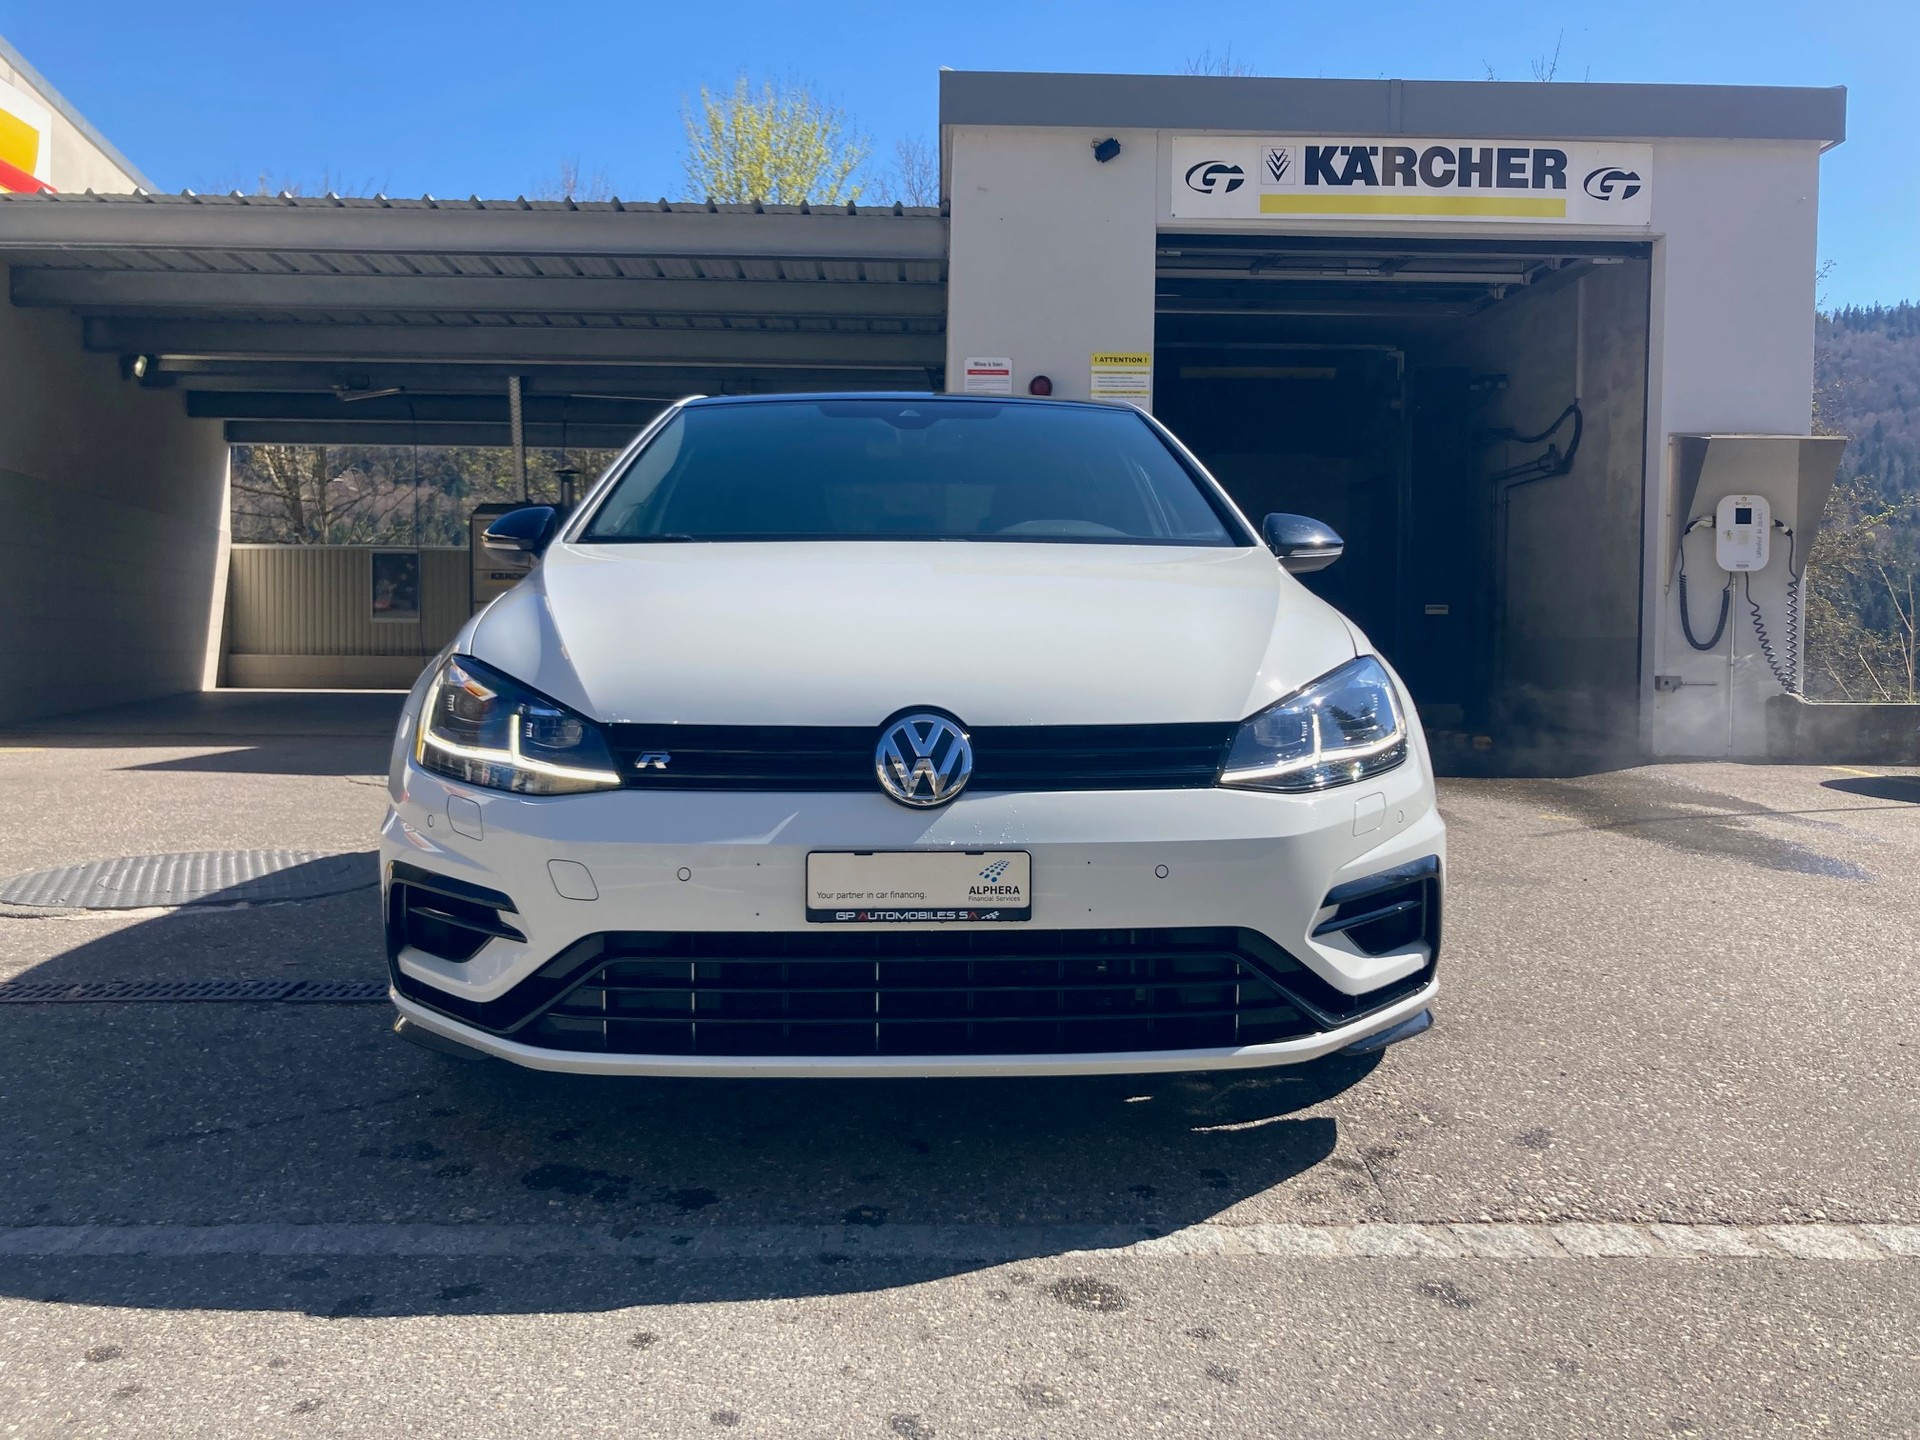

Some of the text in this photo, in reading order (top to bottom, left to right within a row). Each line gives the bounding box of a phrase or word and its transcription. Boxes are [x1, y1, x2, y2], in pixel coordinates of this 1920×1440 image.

[1304, 145, 1568, 189] KÄRCHER
[634, 750, 671, 769] R
[968, 885, 1020, 895] ALPHERA
[816, 891, 927, 900] Your partner in car financing.
[835, 911, 978, 920] GP AUTOMOBILES SA
